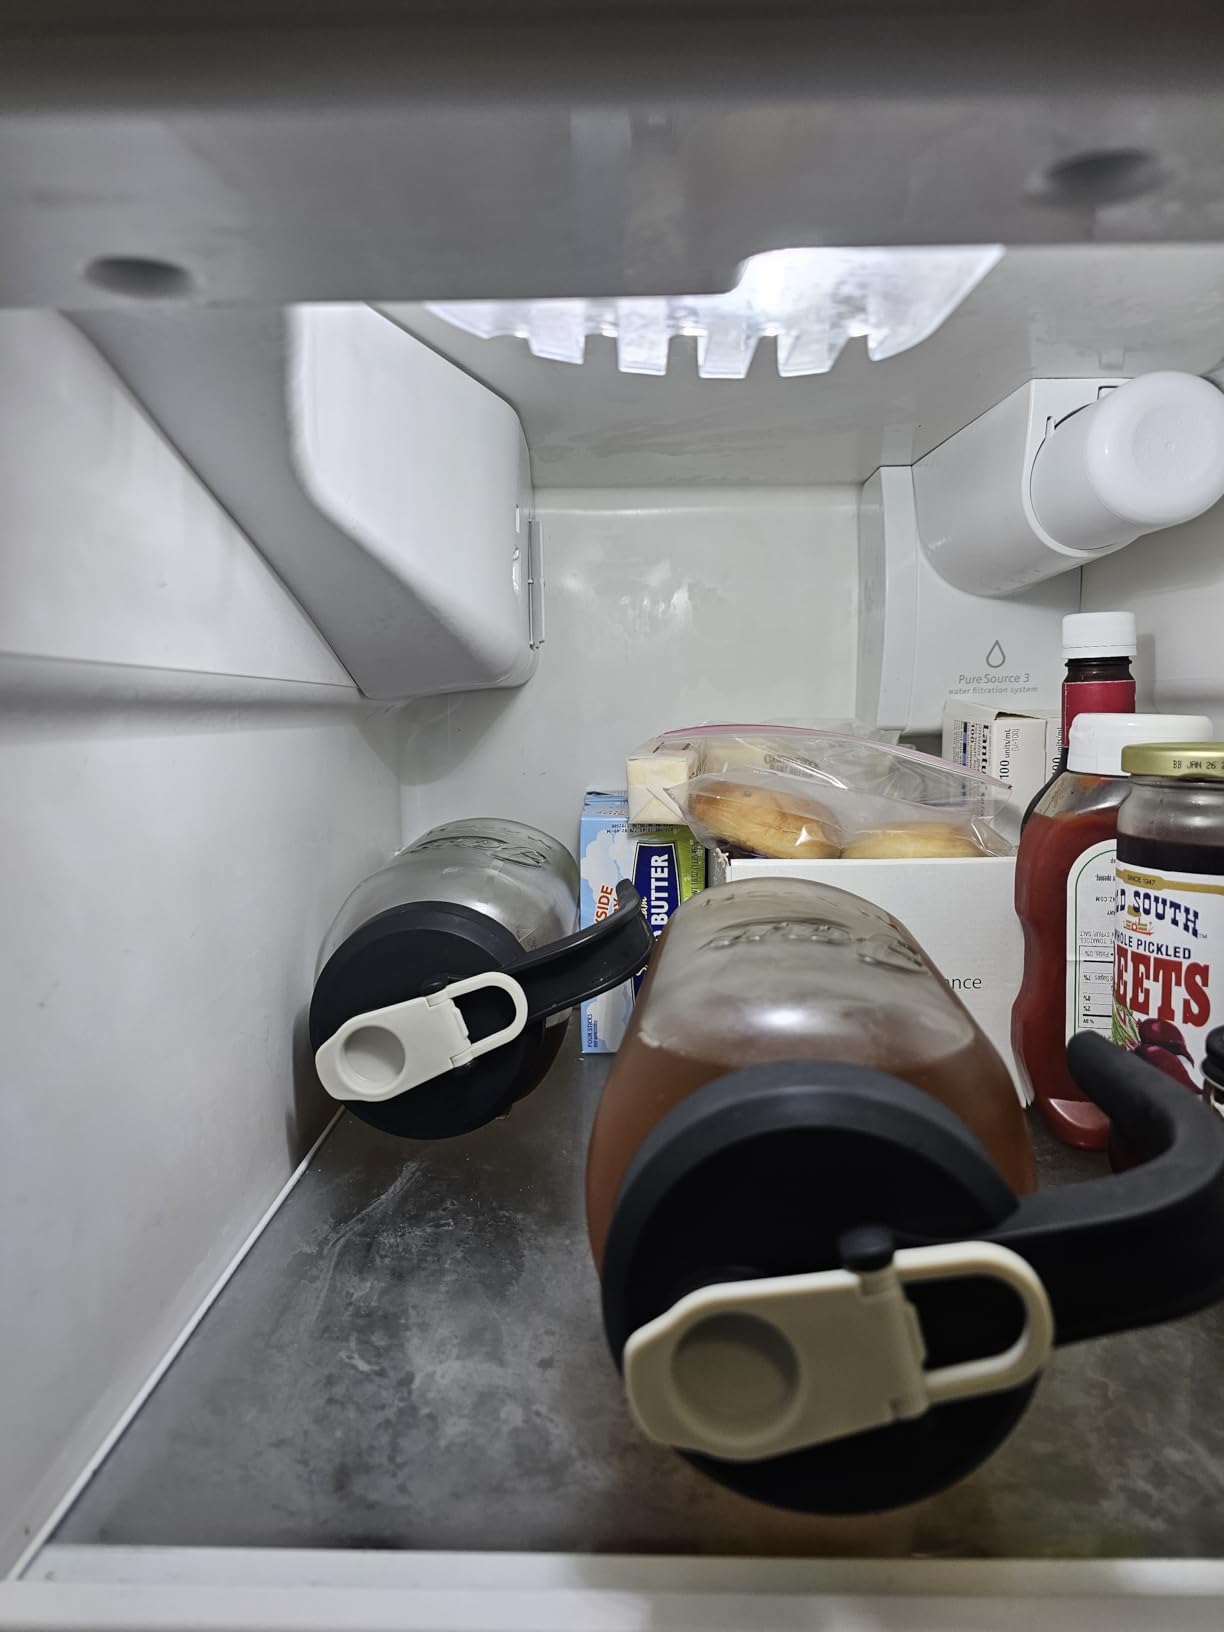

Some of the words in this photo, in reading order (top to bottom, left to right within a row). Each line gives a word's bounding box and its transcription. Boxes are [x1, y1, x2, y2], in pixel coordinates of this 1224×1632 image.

[1023, 673, 1031, 683] 3
[972, 687, 1008, 695] filtration
[1010, 686, 1039, 695] system
[981, 724, 989, 774] Lantu
[1012, 729, 1020, 752] (U-100)
[1000, 760, 1010, 779] 100
[1052, 757, 1061, 775] 00
[1173, 760, 1182, 769] BB
[1187, 761, 1202, 769] JAN
[1206, 761, 1216, 769] 26
[1127, 874, 1141, 883] SINCE
[651, 854, 668, 925] BUTTER
[1133, 890, 1199, 938] SOUTH
[1137, 938, 1191, 960] PICKLED
